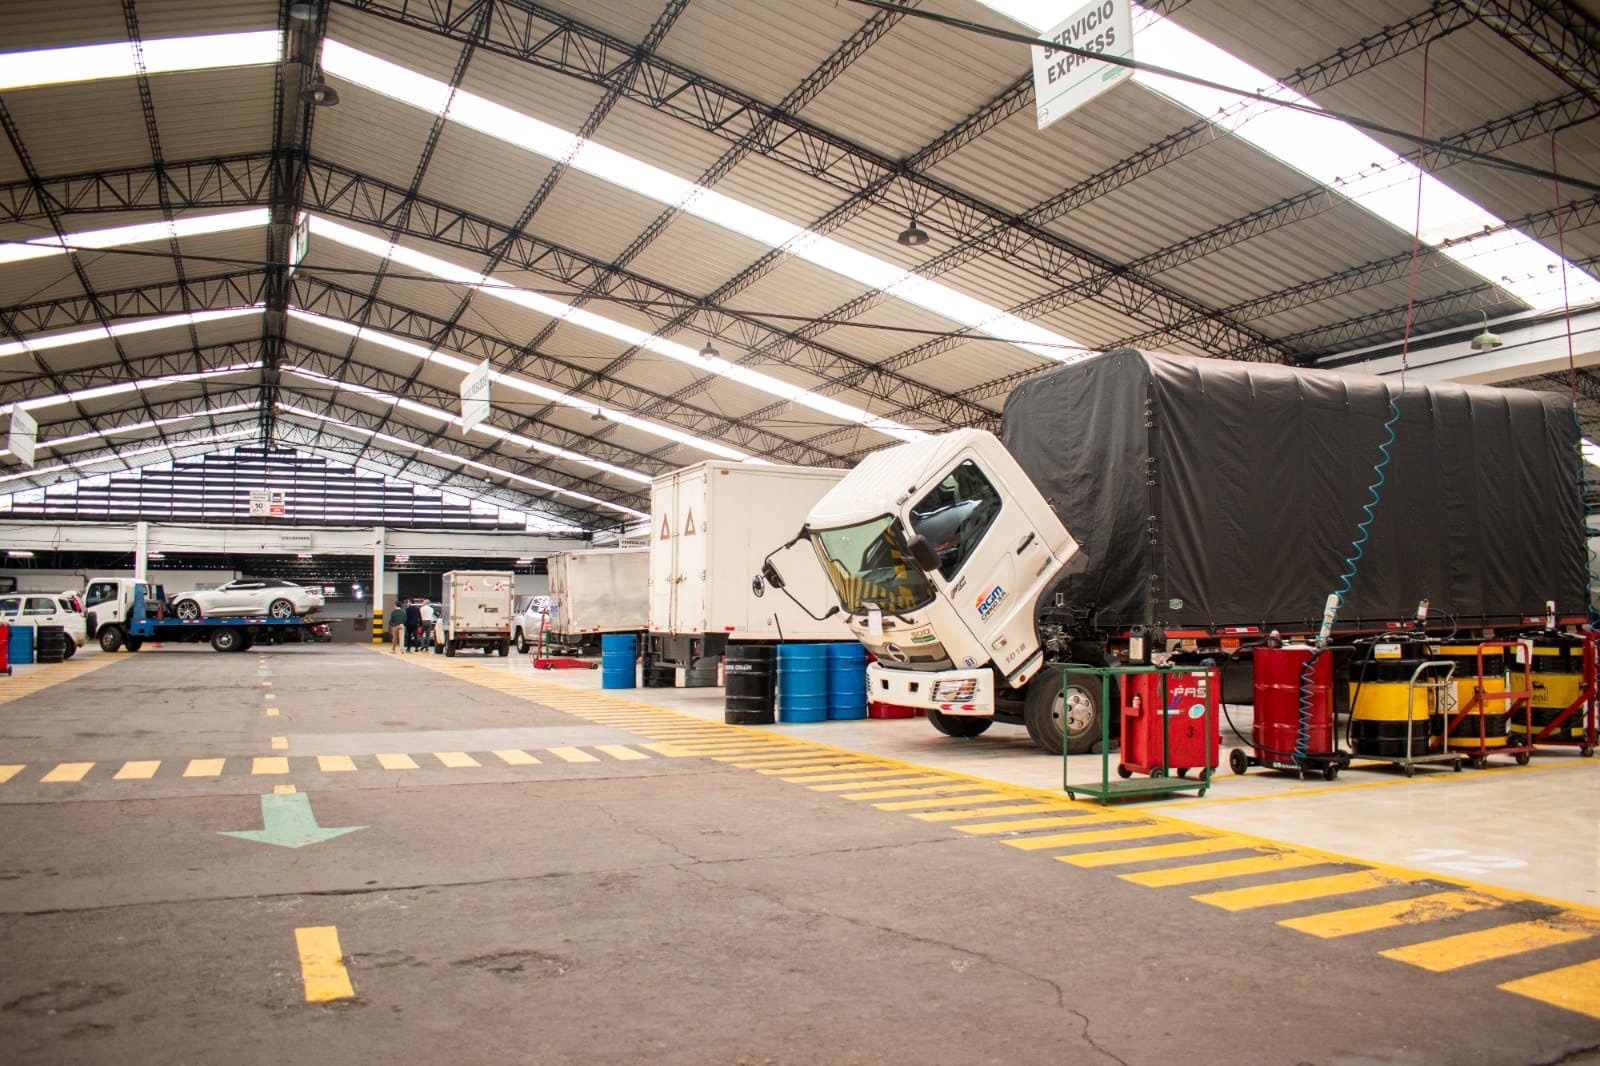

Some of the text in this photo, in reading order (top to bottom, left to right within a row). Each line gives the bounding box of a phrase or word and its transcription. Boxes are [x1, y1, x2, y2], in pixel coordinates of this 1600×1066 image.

[1044, 0, 1114, 59] SERVICIO
[1048, 27, 1115, 85] EXPRESS
[978, 585, 1003, 615] RGM
[981, 600, 998, 621] CARGO
[1186, 725, 1195, 739] 3
